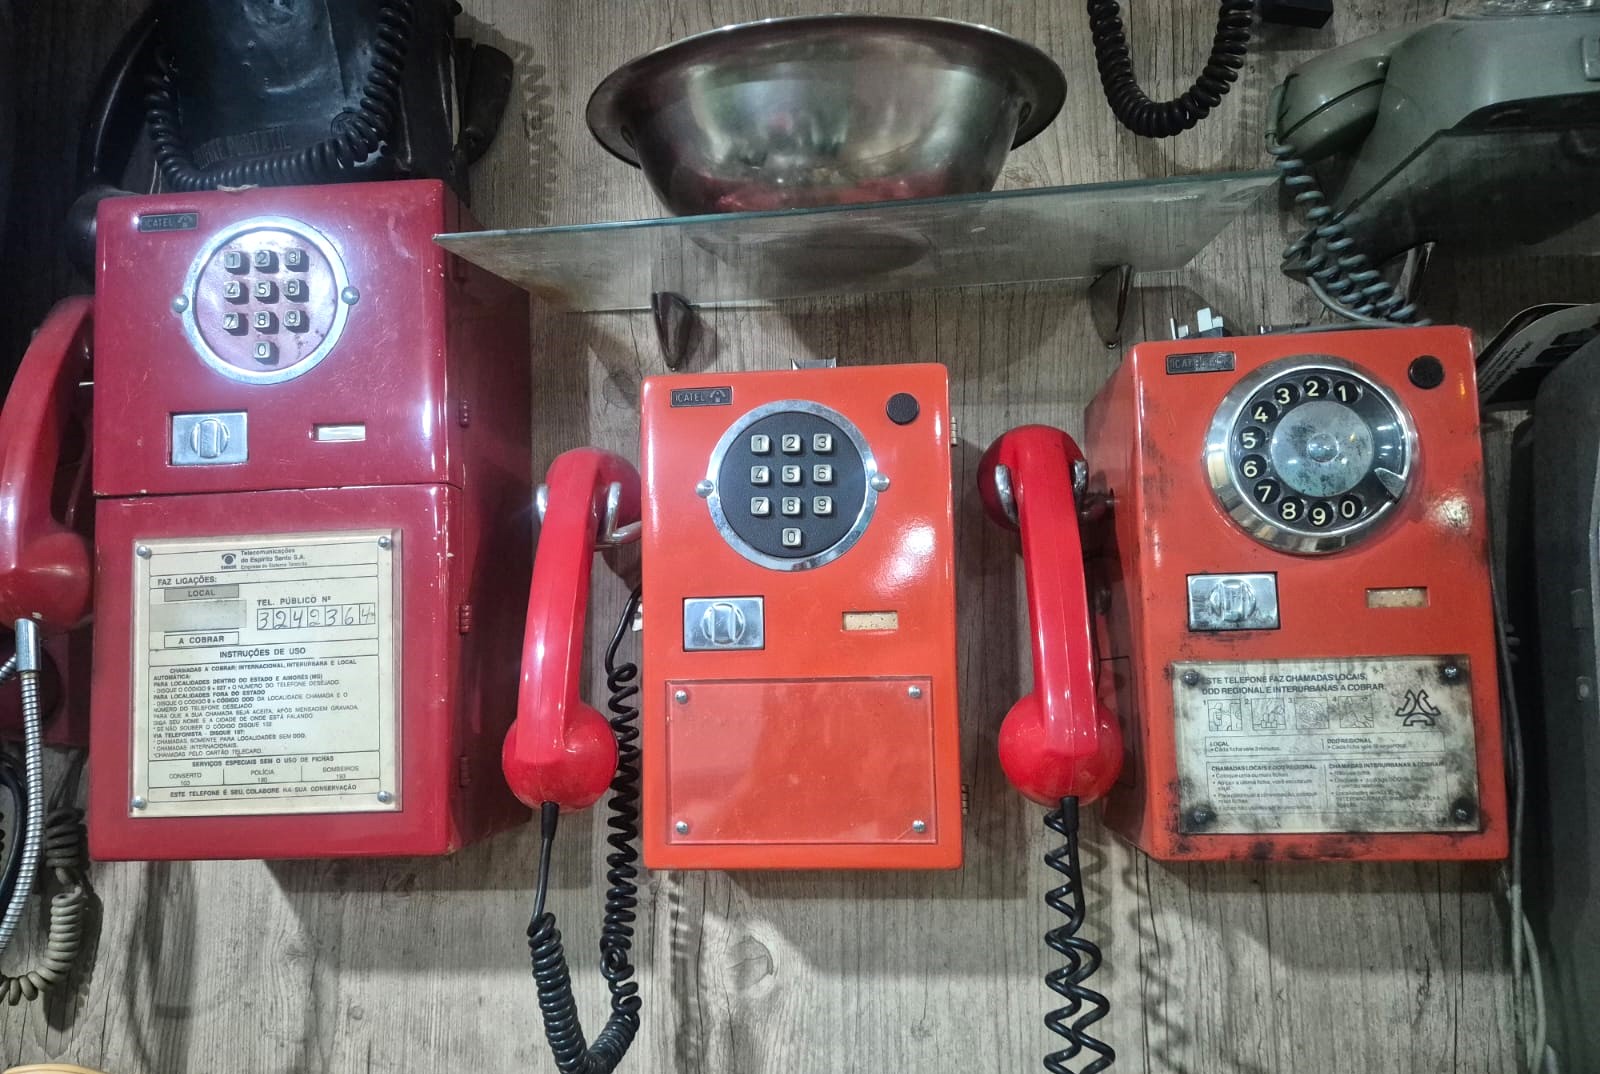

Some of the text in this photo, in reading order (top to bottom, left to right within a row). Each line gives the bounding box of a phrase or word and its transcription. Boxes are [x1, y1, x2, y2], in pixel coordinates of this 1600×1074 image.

[257, 254, 266, 265] 2
[289, 252, 297, 263] 3
[227, 281, 296, 294] 4 5 6
[227, 312, 297, 327] 7 8 9
[258, 345, 266, 356] 0
[1277, 380, 1346, 404] 3 2 1
[1254, 407, 1268, 422] 4
[786, 437, 795, 449] 2
[818, 437, 827, 448] 3
[1243, 433, 1255, 448] 5
[755, 468, 826, 480] 4 5 6
[1244, 462, 1257, 478] 6
[1258, 486, 1271, 502] 7
[755, 499, 826, 512] 7 8 9
[1282, 503, 1296, 520] 8
[1342, 502, 1355, 517] 0
[1313, 508, 1326, 525] 9
[788, 531, 795, 543] 0
[175, 576, 217, 586] LIGAÇÕES:
[280, 596, 316, 605] PÚBLICO
[189, 635, 224, 644] COBRAR
[220, 648, 270, 658] INSTRUÇÕES
[1224, 676, 1267, 684] TELEFONE
[1286, 673, 1334, 682] CHAMADAS
[1202, 687, 1220, 695] DDD
[1222, 686, 1265, 694] REGIONAL
[1273, 684, 1339, 694] INTERURBANAS
[322, 765, 359, 773] BOMBEIROS
[189, 789, 219, 797] TELEFONE
[311, 784, 356, 792] CONSERVAÇÃO
